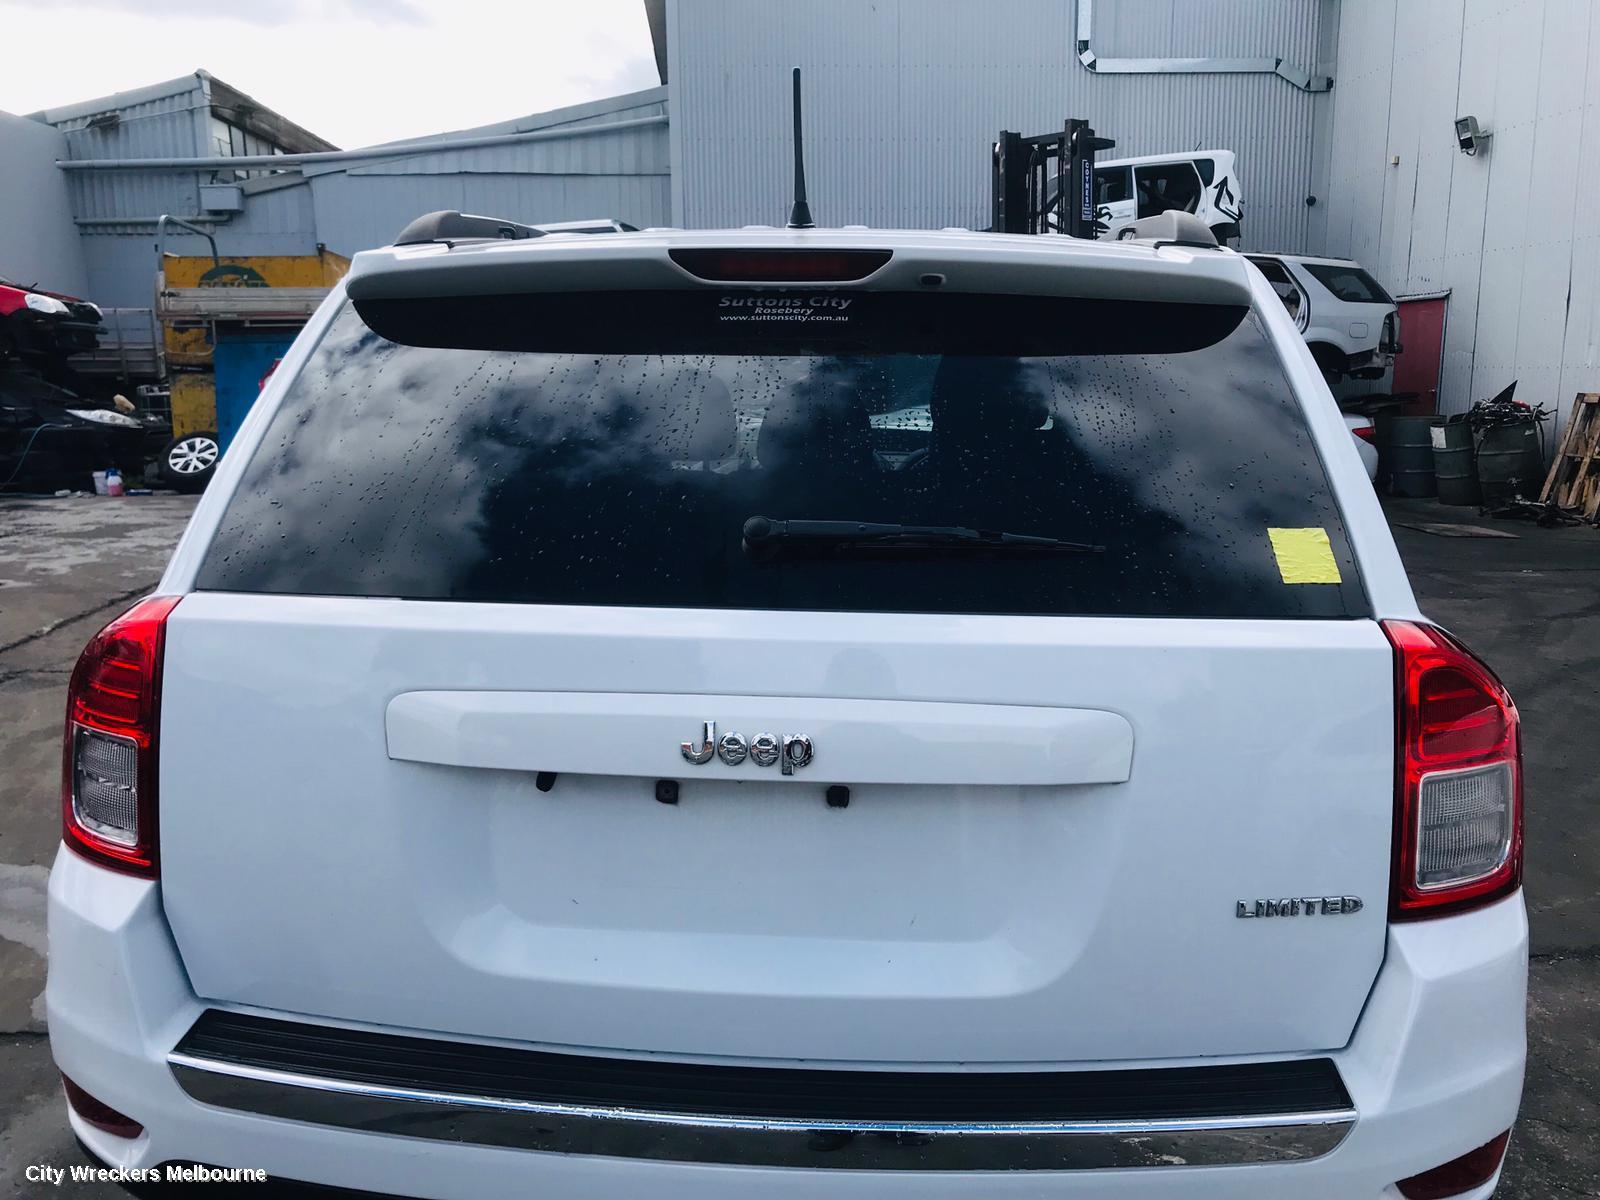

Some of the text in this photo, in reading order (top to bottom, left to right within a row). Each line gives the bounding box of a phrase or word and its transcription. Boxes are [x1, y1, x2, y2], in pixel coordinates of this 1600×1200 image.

[719, 296, 852, 310] Suttons City
[720, 314, 849, 322] www.suttonscity.com.au
[754, 307, 814, 316] Rosebery
[680, 720, 815, 776] Jeep
[1236, 895, 1363, 918] LIMITED
